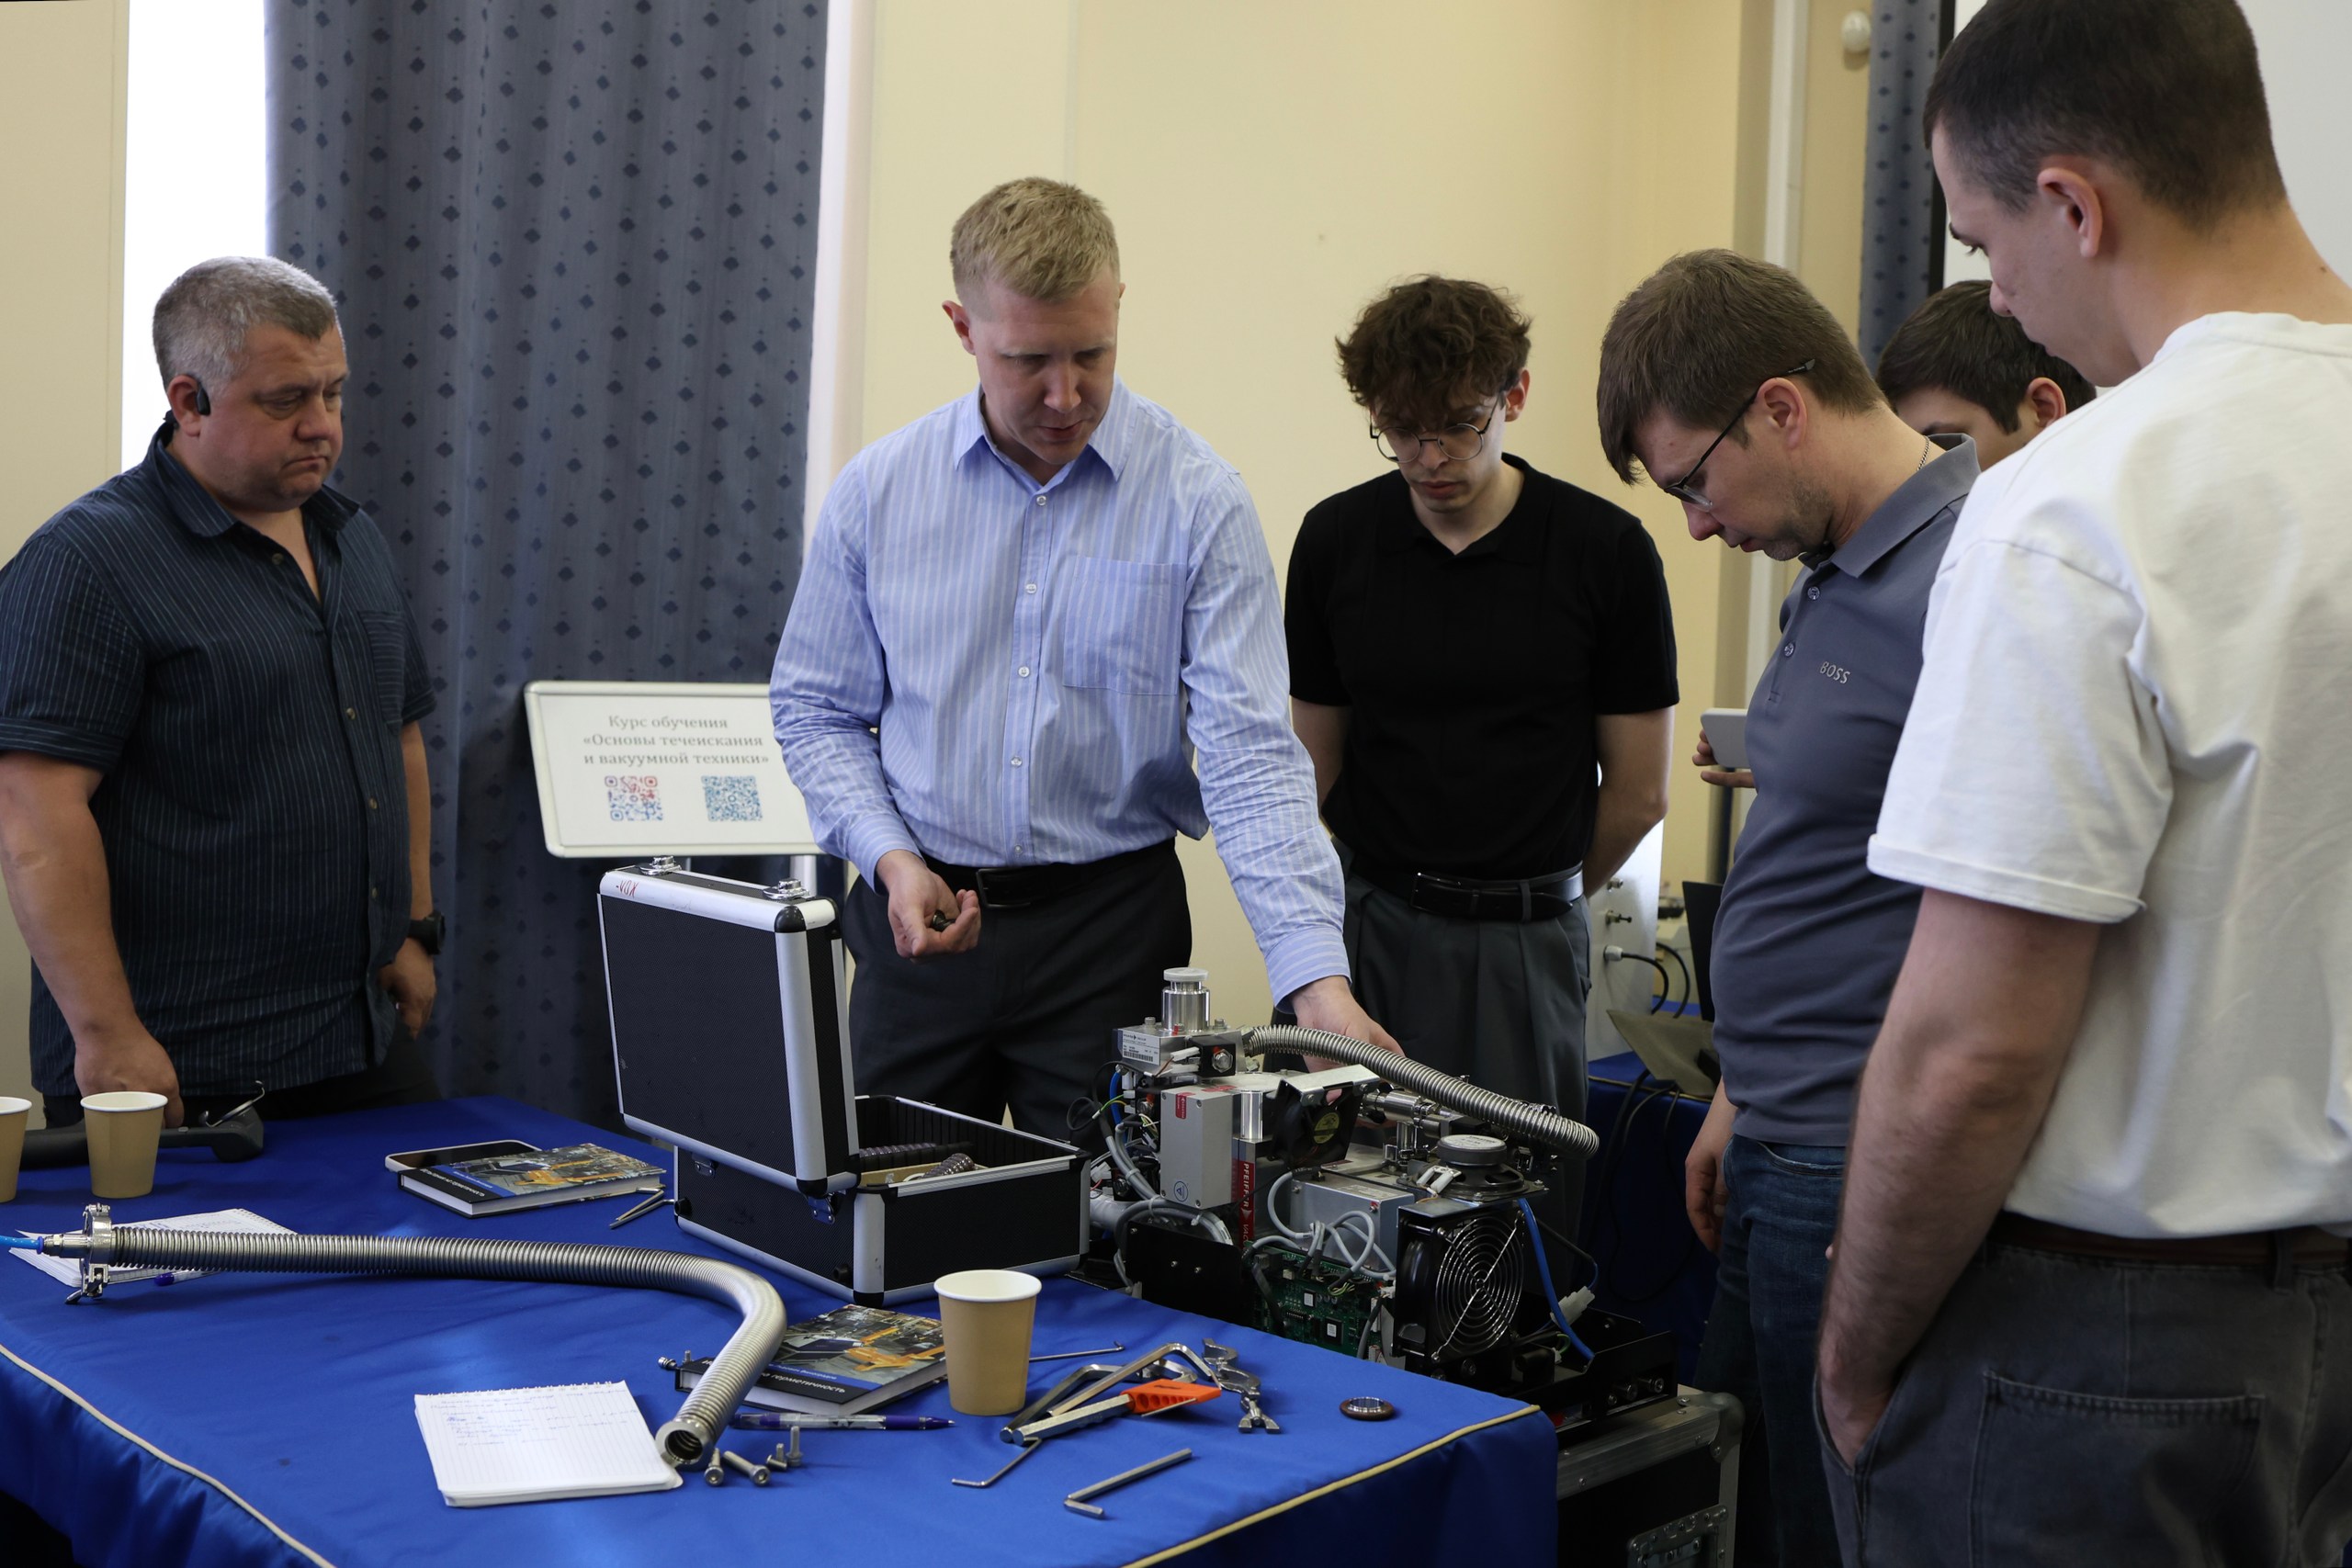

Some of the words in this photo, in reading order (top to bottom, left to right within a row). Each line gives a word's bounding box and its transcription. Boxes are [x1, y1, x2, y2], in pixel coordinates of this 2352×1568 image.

[1819, 660, 1851, 684] BOSS
[608, 715, 648, 729] Курс
[650, 716, 729, 730] обучения
[582, 734, 656, 747] «Основы
[659, 735, 763, 748] течеискания
[583, 754, 594, 764] и
[598, 751, 690, 767] вакуумной
[693, 753, 770, 765] техники»
[772, 1372, 845, 1393] герметичность
